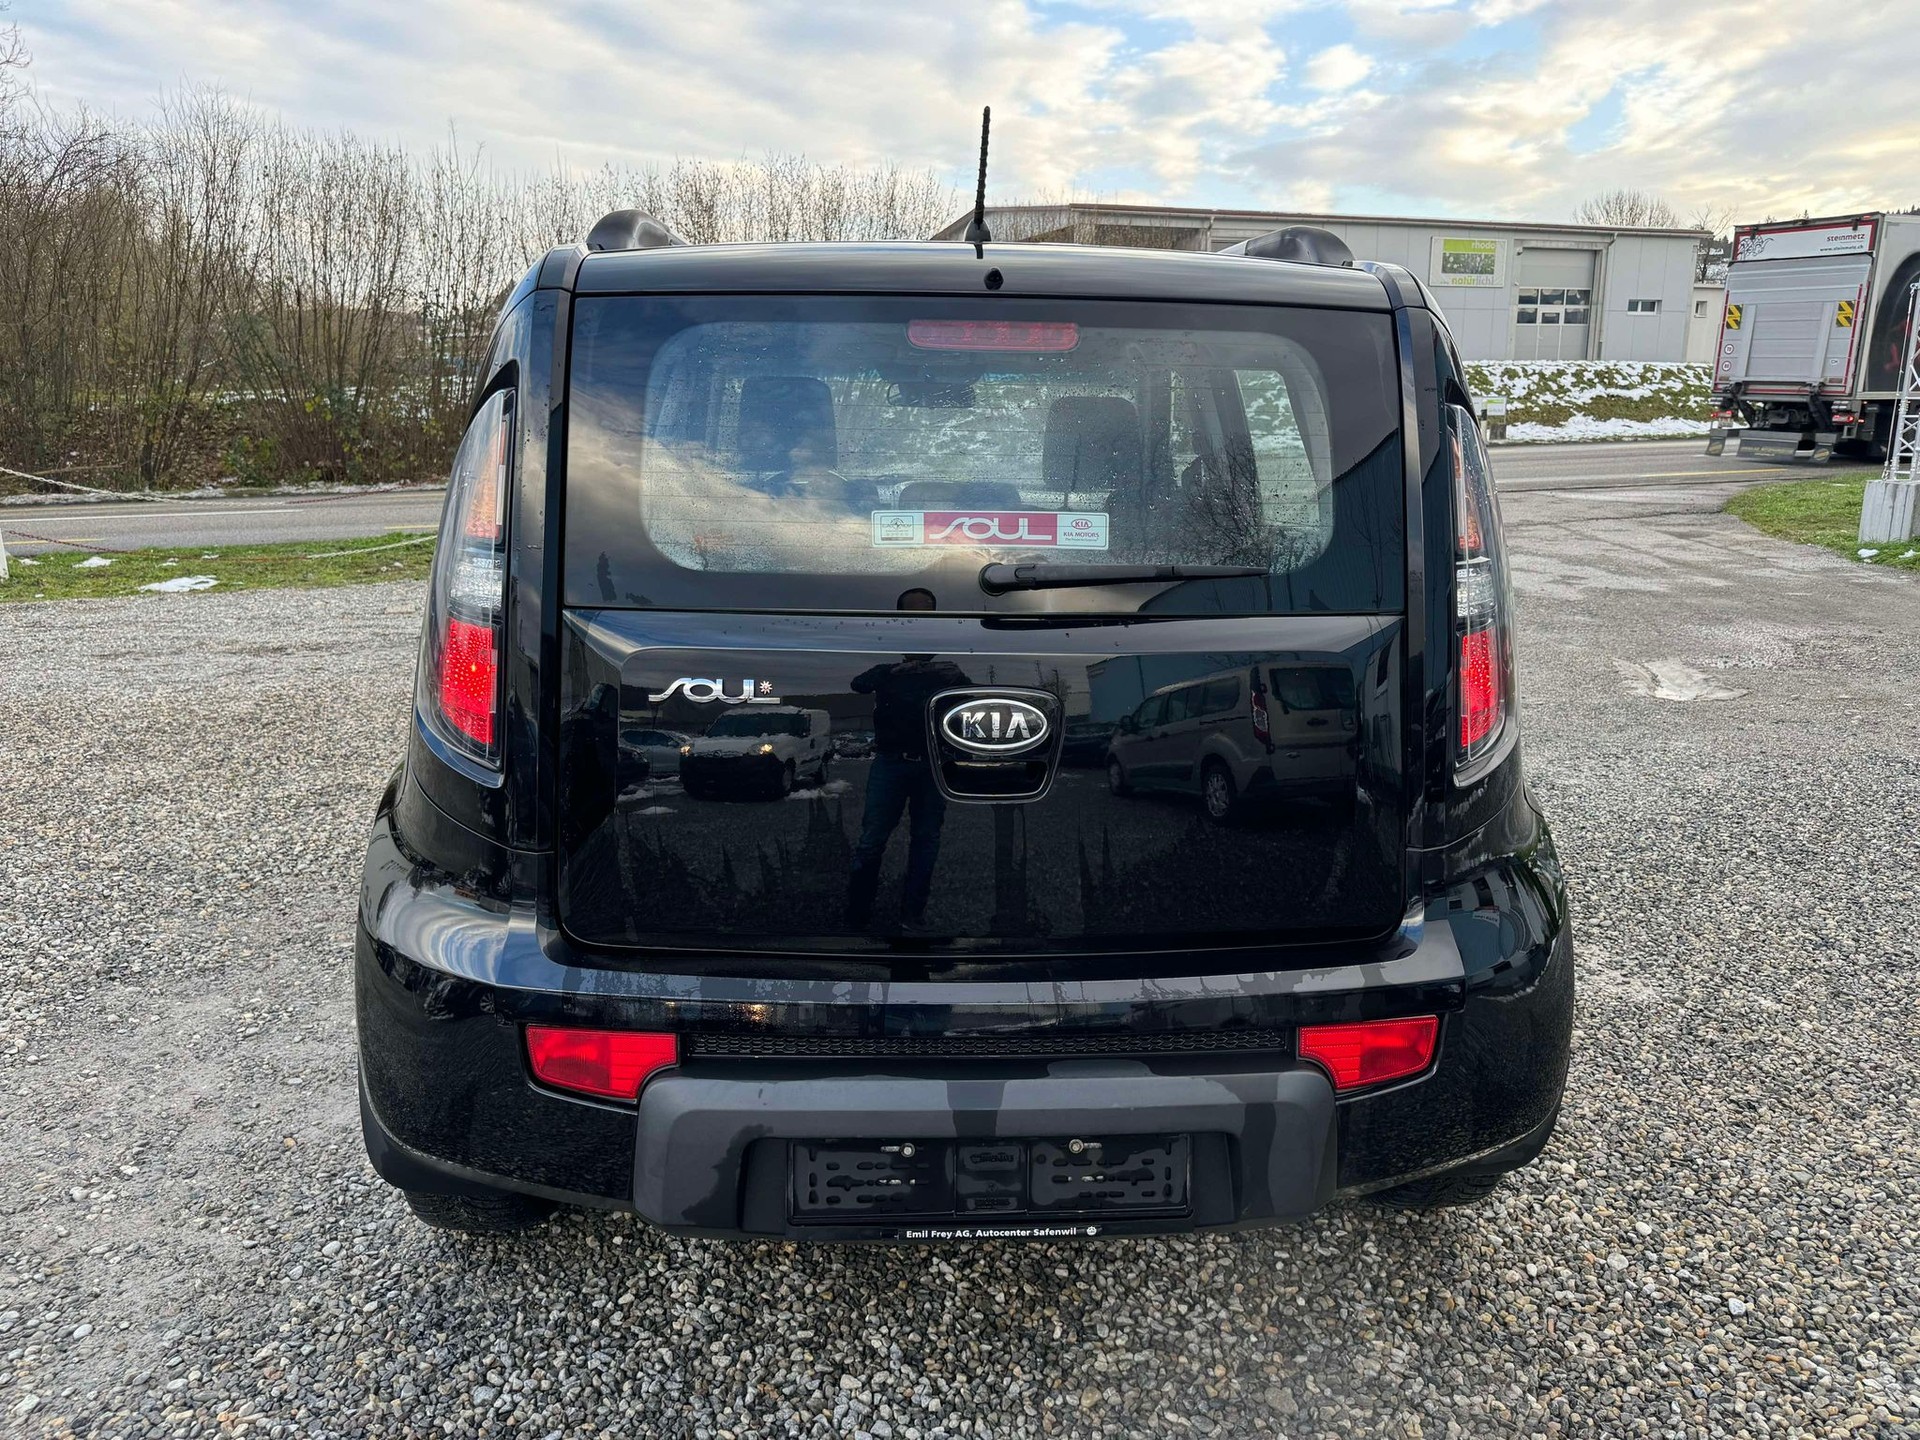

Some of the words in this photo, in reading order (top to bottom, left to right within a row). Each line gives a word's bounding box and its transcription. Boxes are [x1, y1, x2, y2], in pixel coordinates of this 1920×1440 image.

[1826, 233, 1866, 242] steinmetz
[928, 517, 1053, 541] SOUL
[648, 677, 781, 704] SOUL
[960, 711, 1032, 739] KIA
[906, 1230, 928, 1239] Emil
[931, 1230, 953, 1240] Frey
[955, 1229, 973, 1239] AG,
[975, 1228, 1031, 1238] Autocenter
[1033, 1227, 1077, 1237] Safenwil
